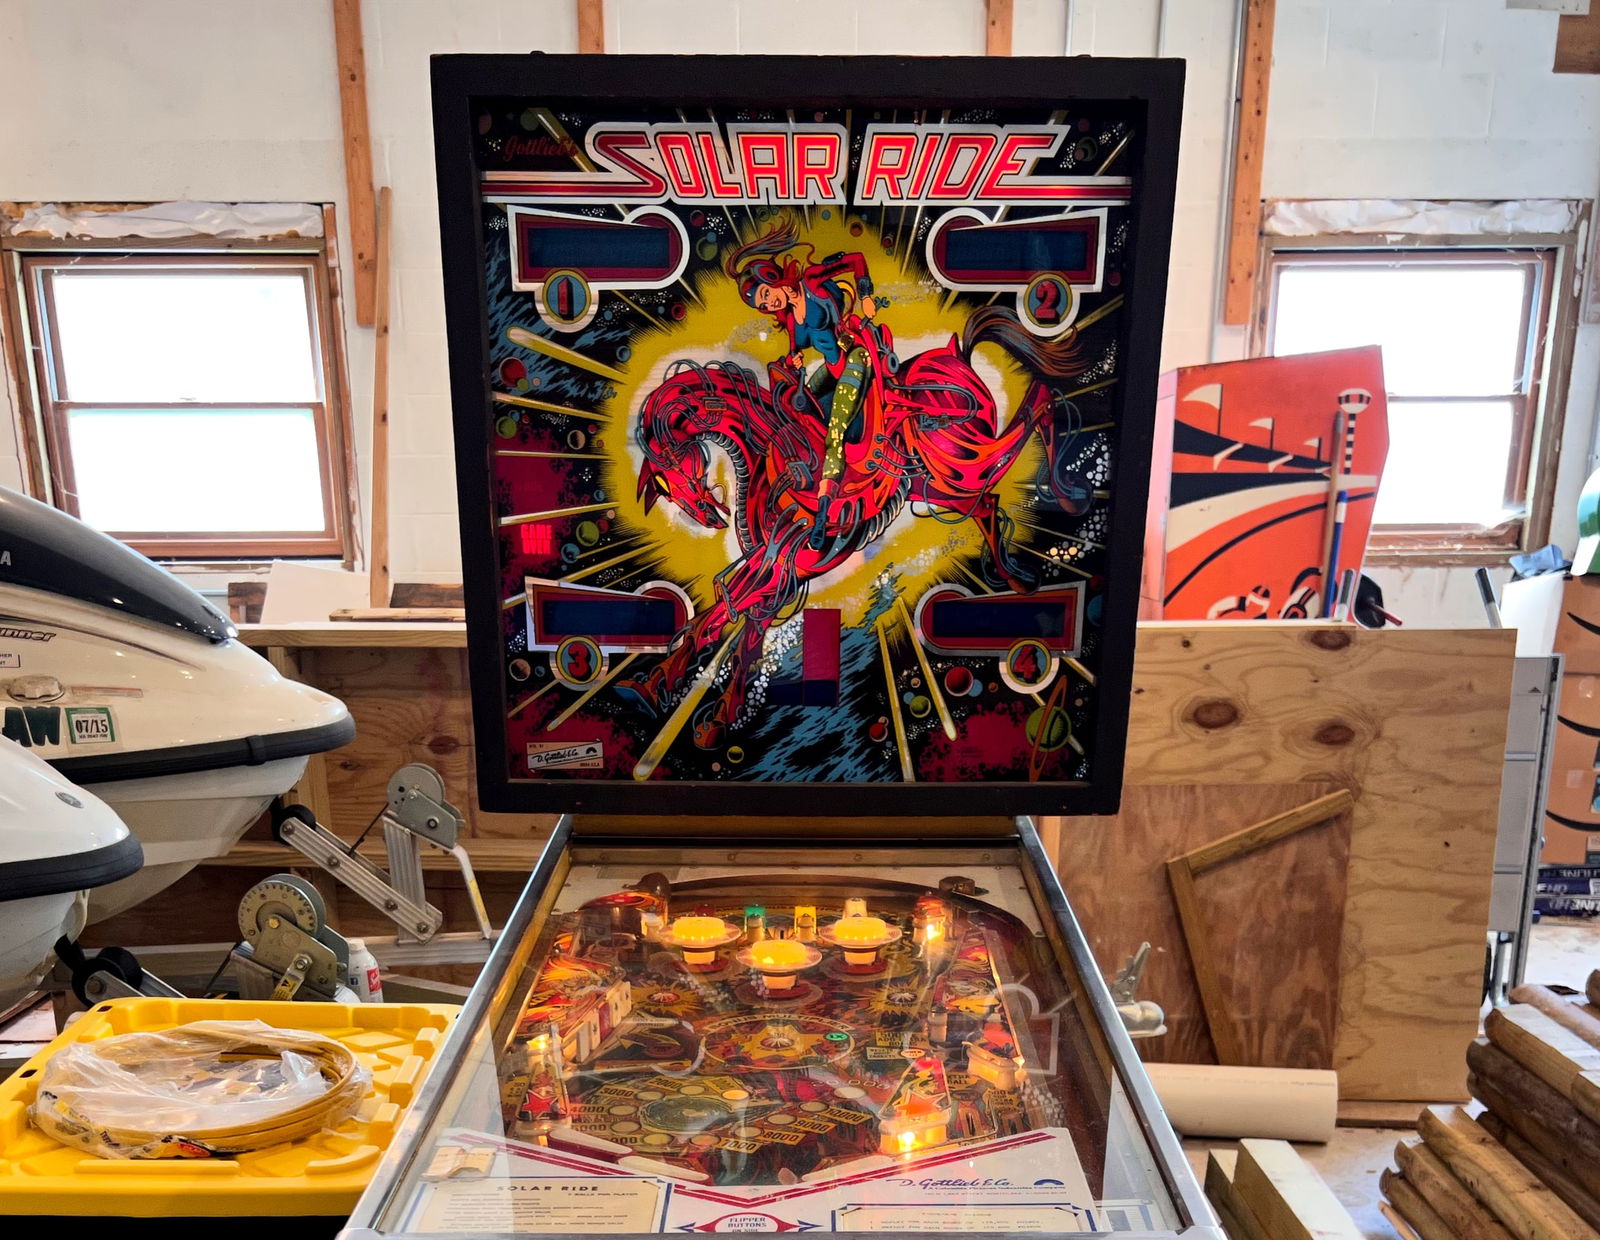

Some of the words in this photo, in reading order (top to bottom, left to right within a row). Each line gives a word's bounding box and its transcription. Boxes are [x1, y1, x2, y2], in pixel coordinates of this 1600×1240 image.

[588, 124, 847, 204] SOLAR
[856, 124, 1068, 204] RIDE
[556, 276, 575, 320] 1
[1035, 279, 1060, 321] 2
[521, 523, 552, 539] GAME
[567, 642, 591, 679] 3
[1012, 645, 1038, 680] 4
[75, 719, 109, 734] 07/15
[600, 1086, 634, 1098] 3000
[795, 1120, 829, 1131] 9000
[721, 1138, 756, 1150] 7000
[763, 1131, 799, 1142] 8000
